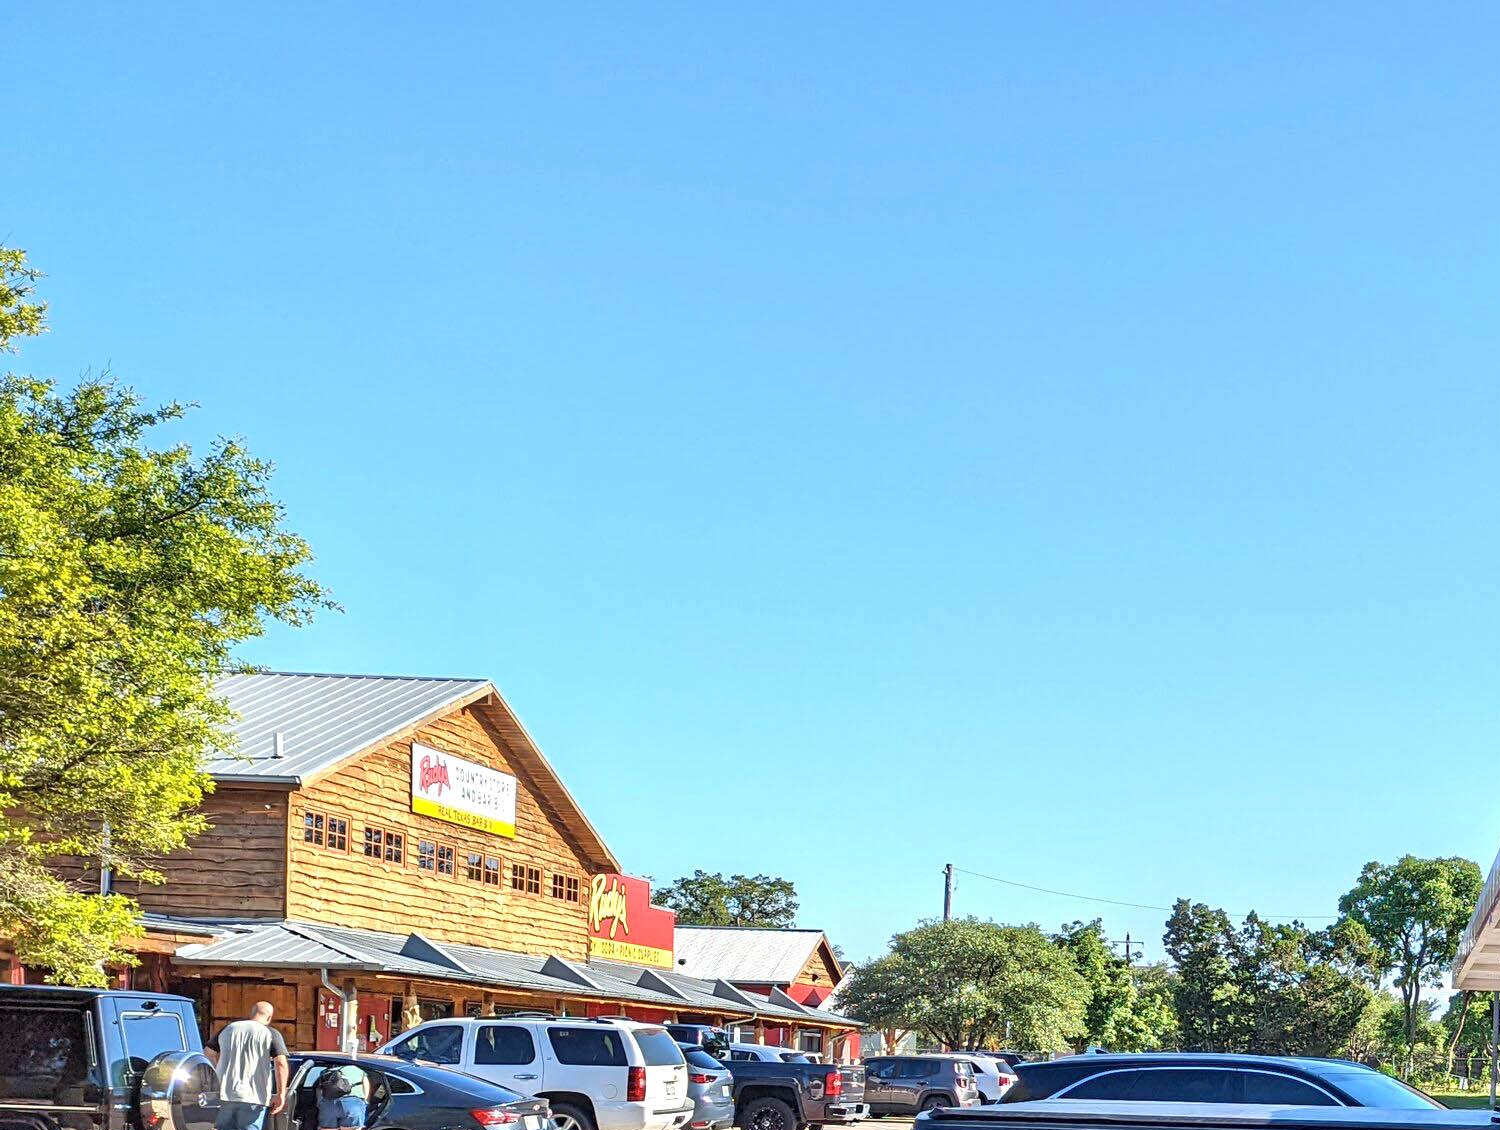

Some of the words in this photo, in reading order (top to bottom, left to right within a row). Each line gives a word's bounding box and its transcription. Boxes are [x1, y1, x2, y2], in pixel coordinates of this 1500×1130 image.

[461, 787, 476, 803] AND
[438, 805, 452, 819] REAL
[453, 809, 471, 824] TEXAS
[589, 873, 629, 940] Rudy's
